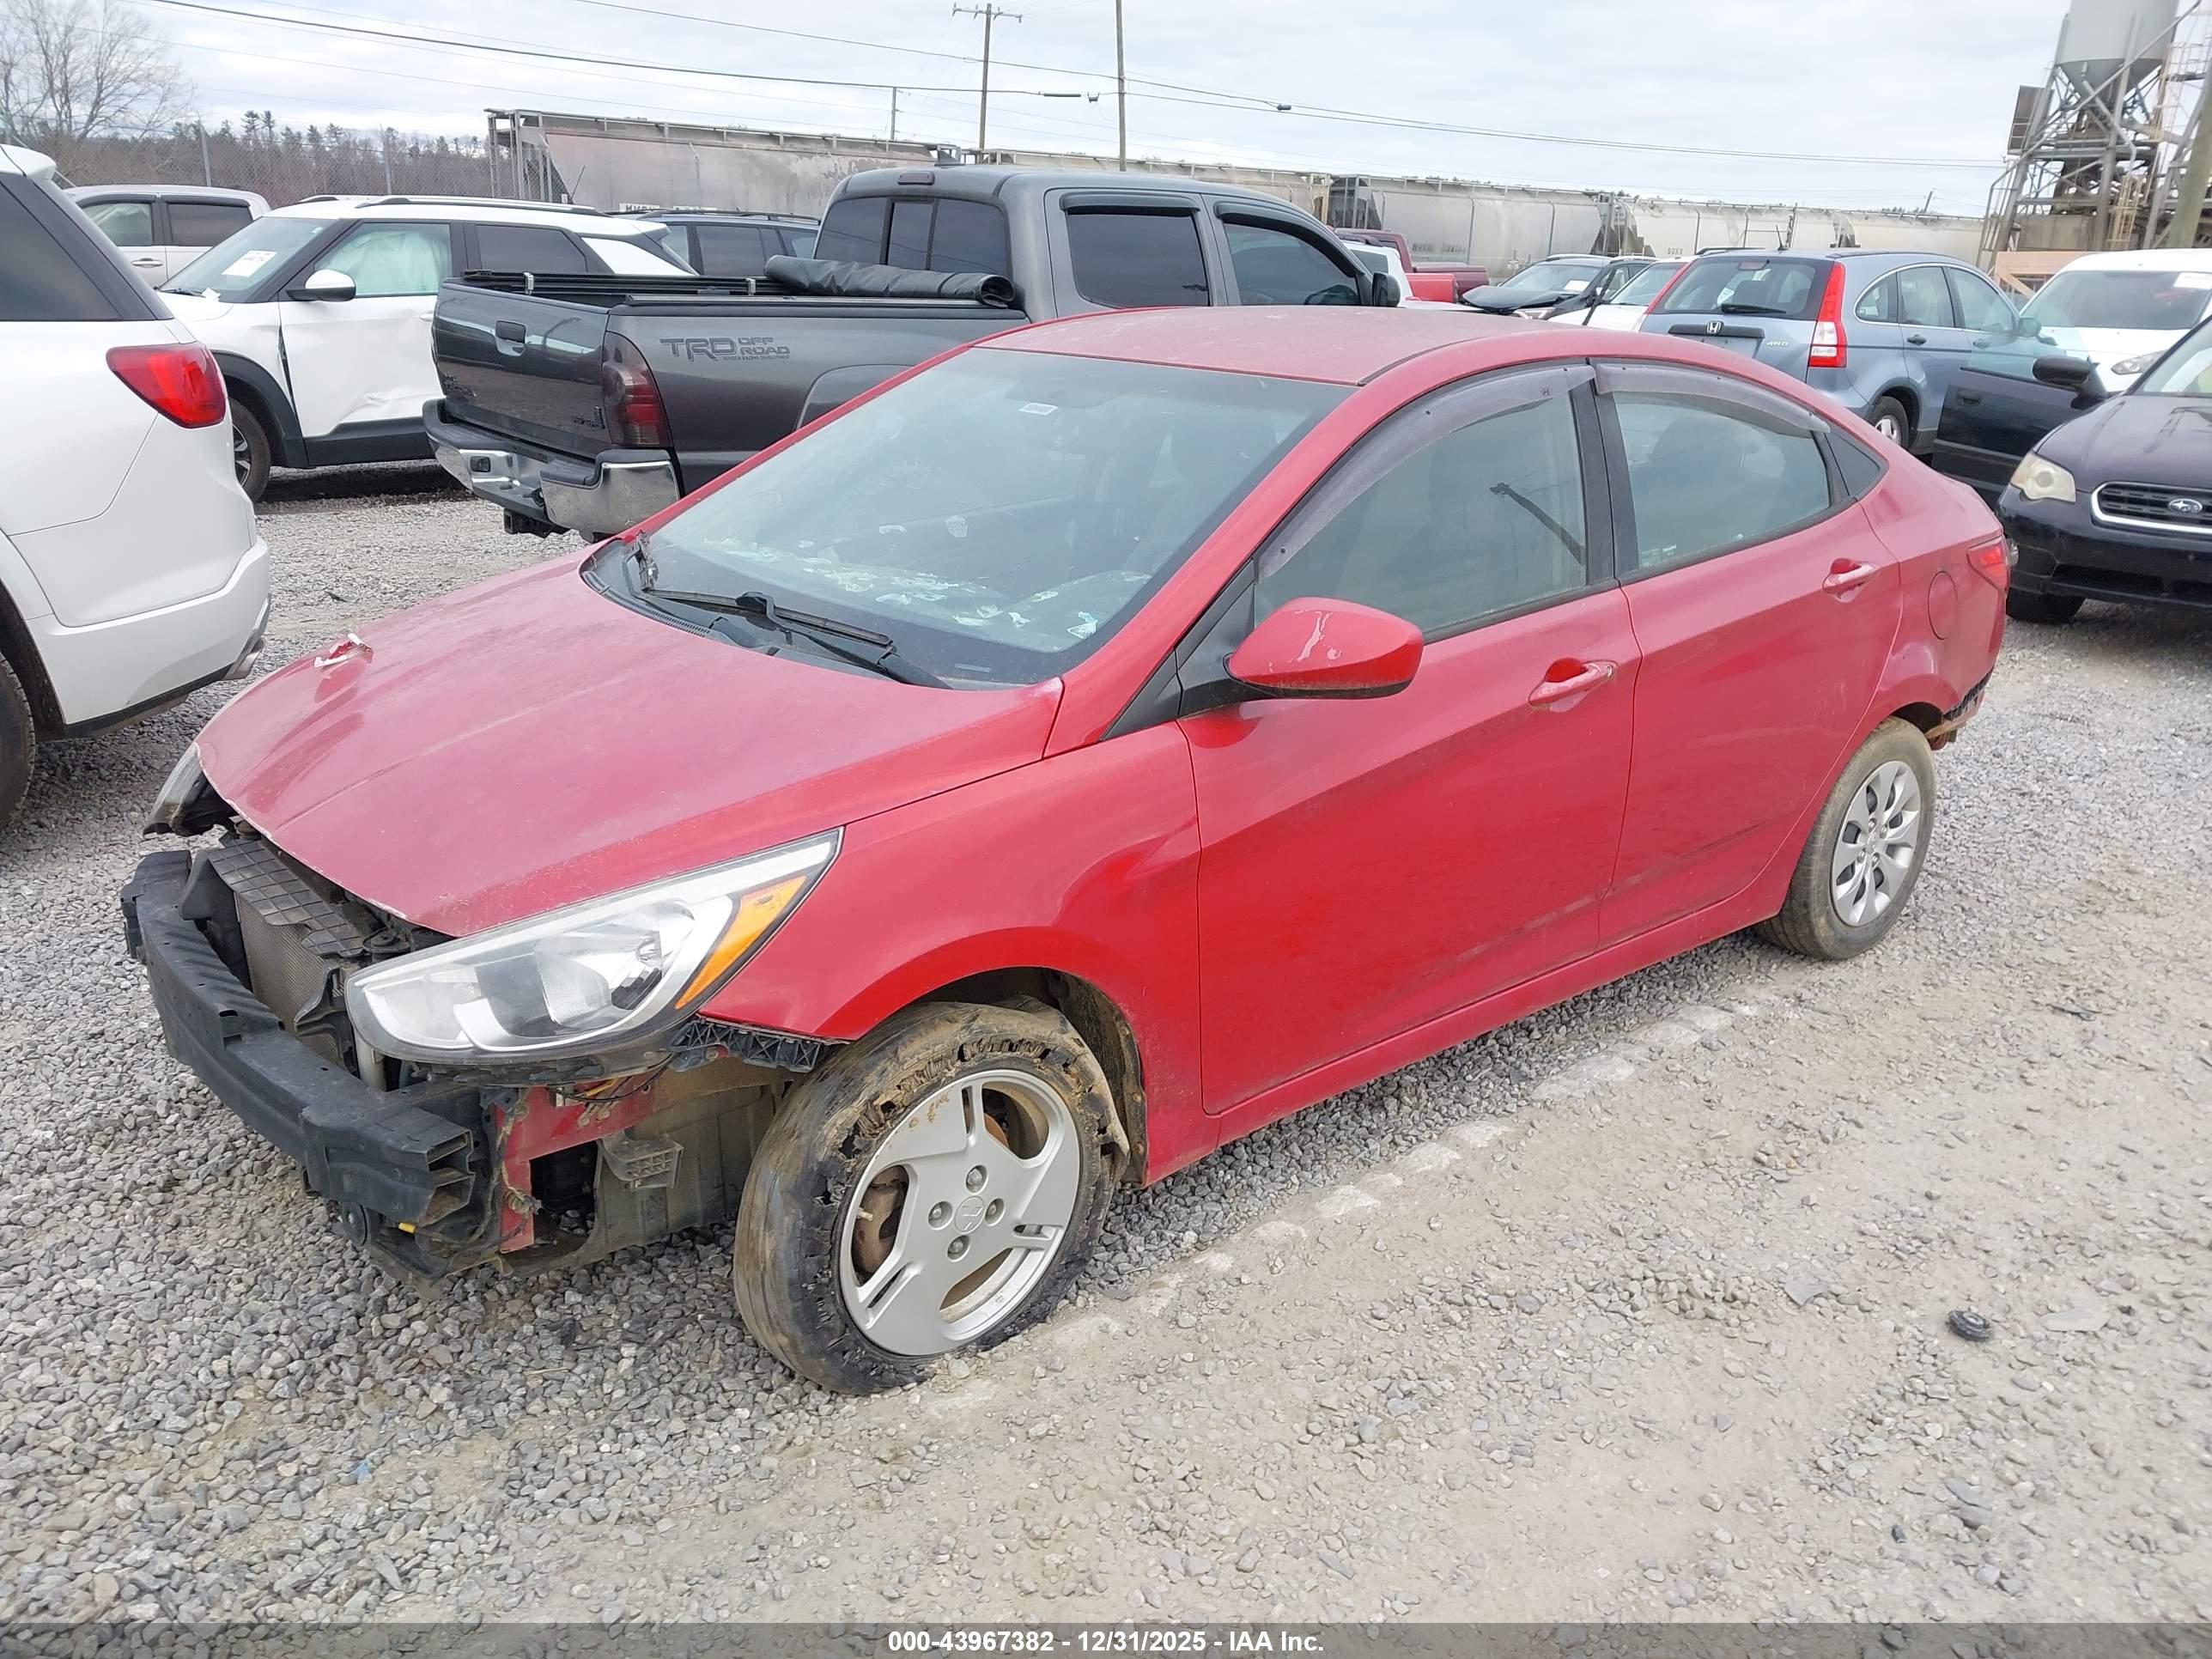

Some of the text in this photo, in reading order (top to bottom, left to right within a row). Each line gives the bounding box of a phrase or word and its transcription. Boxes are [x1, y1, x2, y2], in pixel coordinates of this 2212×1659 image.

[738, 337, 775, 345] OFF
[659, 337, 737, 362] TRD
[740, 346, 790, 356] ROAD
